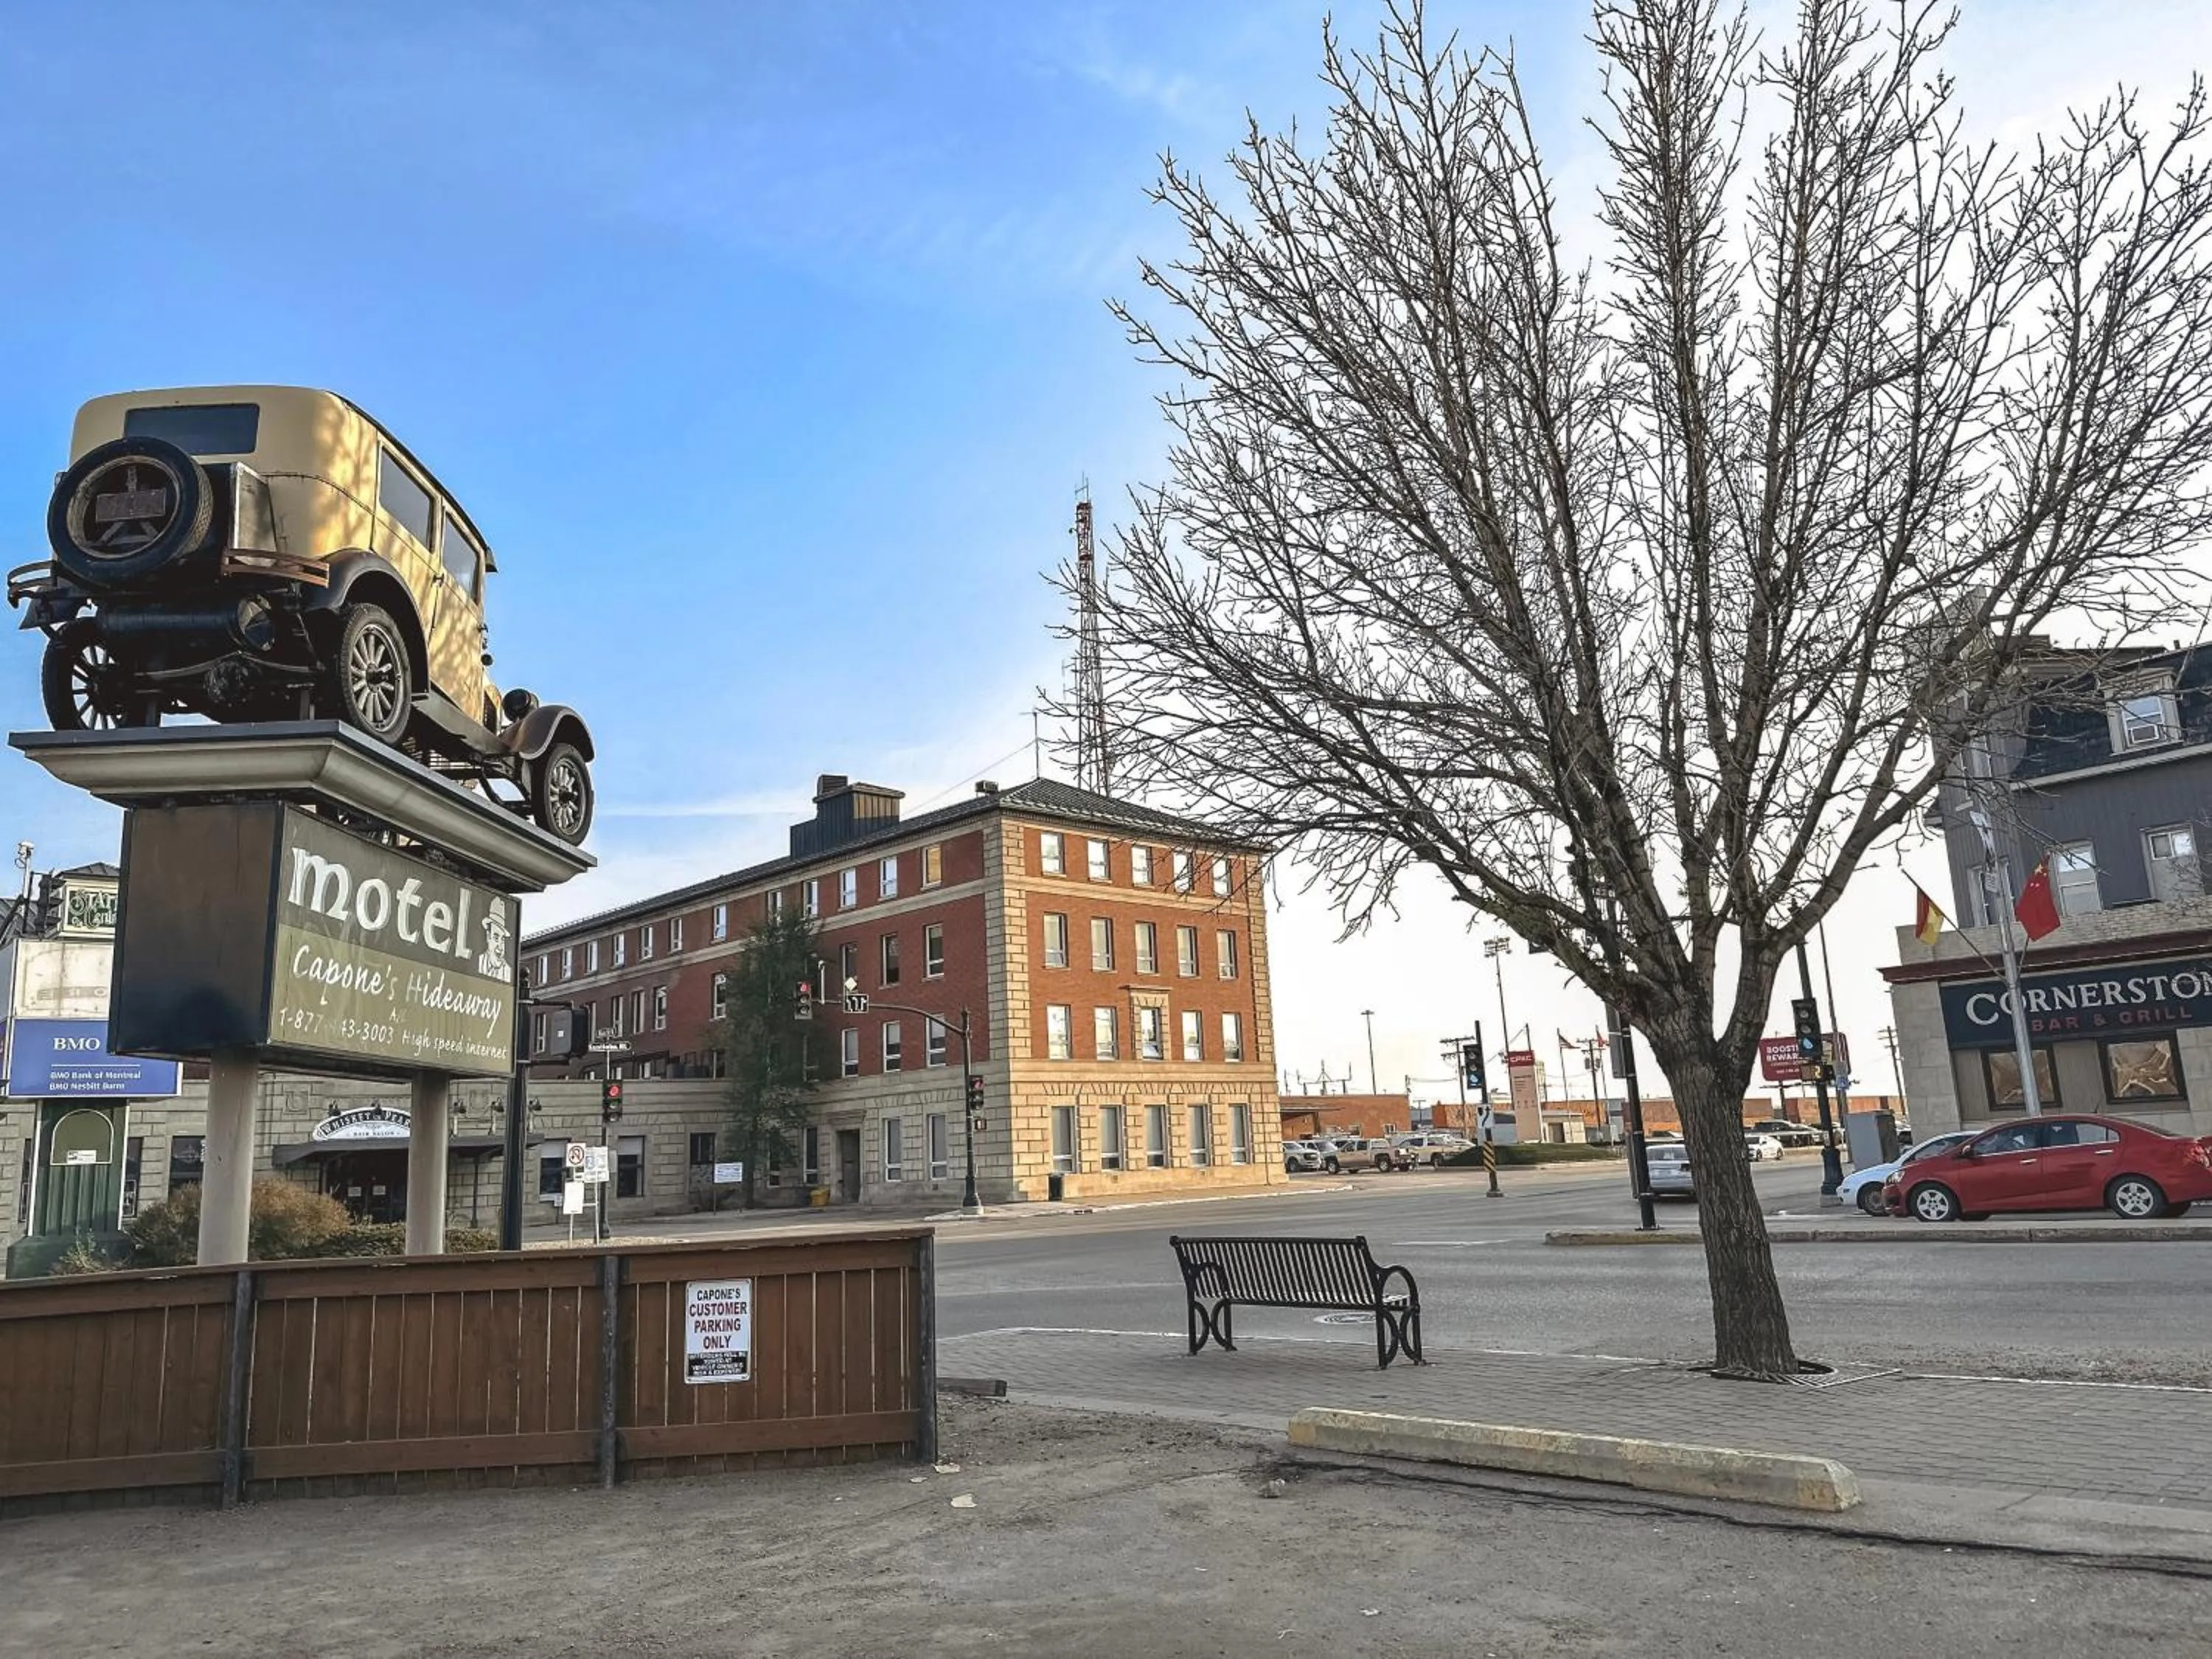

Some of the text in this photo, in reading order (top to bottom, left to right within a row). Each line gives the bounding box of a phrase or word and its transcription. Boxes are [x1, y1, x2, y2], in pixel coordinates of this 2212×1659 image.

[288, 847, 473, 960] motel
[293, 945, 399, 1005] Capone's
[406, 971, 501, 1038] Hideaway
[2032, 1006, 2192, 1032] BAR & GRILL
[52, 1037, 100, 1051] BMO
[402, 1029, 431, 1056] High
[433, 1034, 463, 1057] speed
[697, 1288, 741, 1301] CAPONE'S
[689, 1301, 748, 1317] CUSTOMER
[695, 1318, 741, 1333] PARKING
[703, 1335, 731, 1349] ONLY
